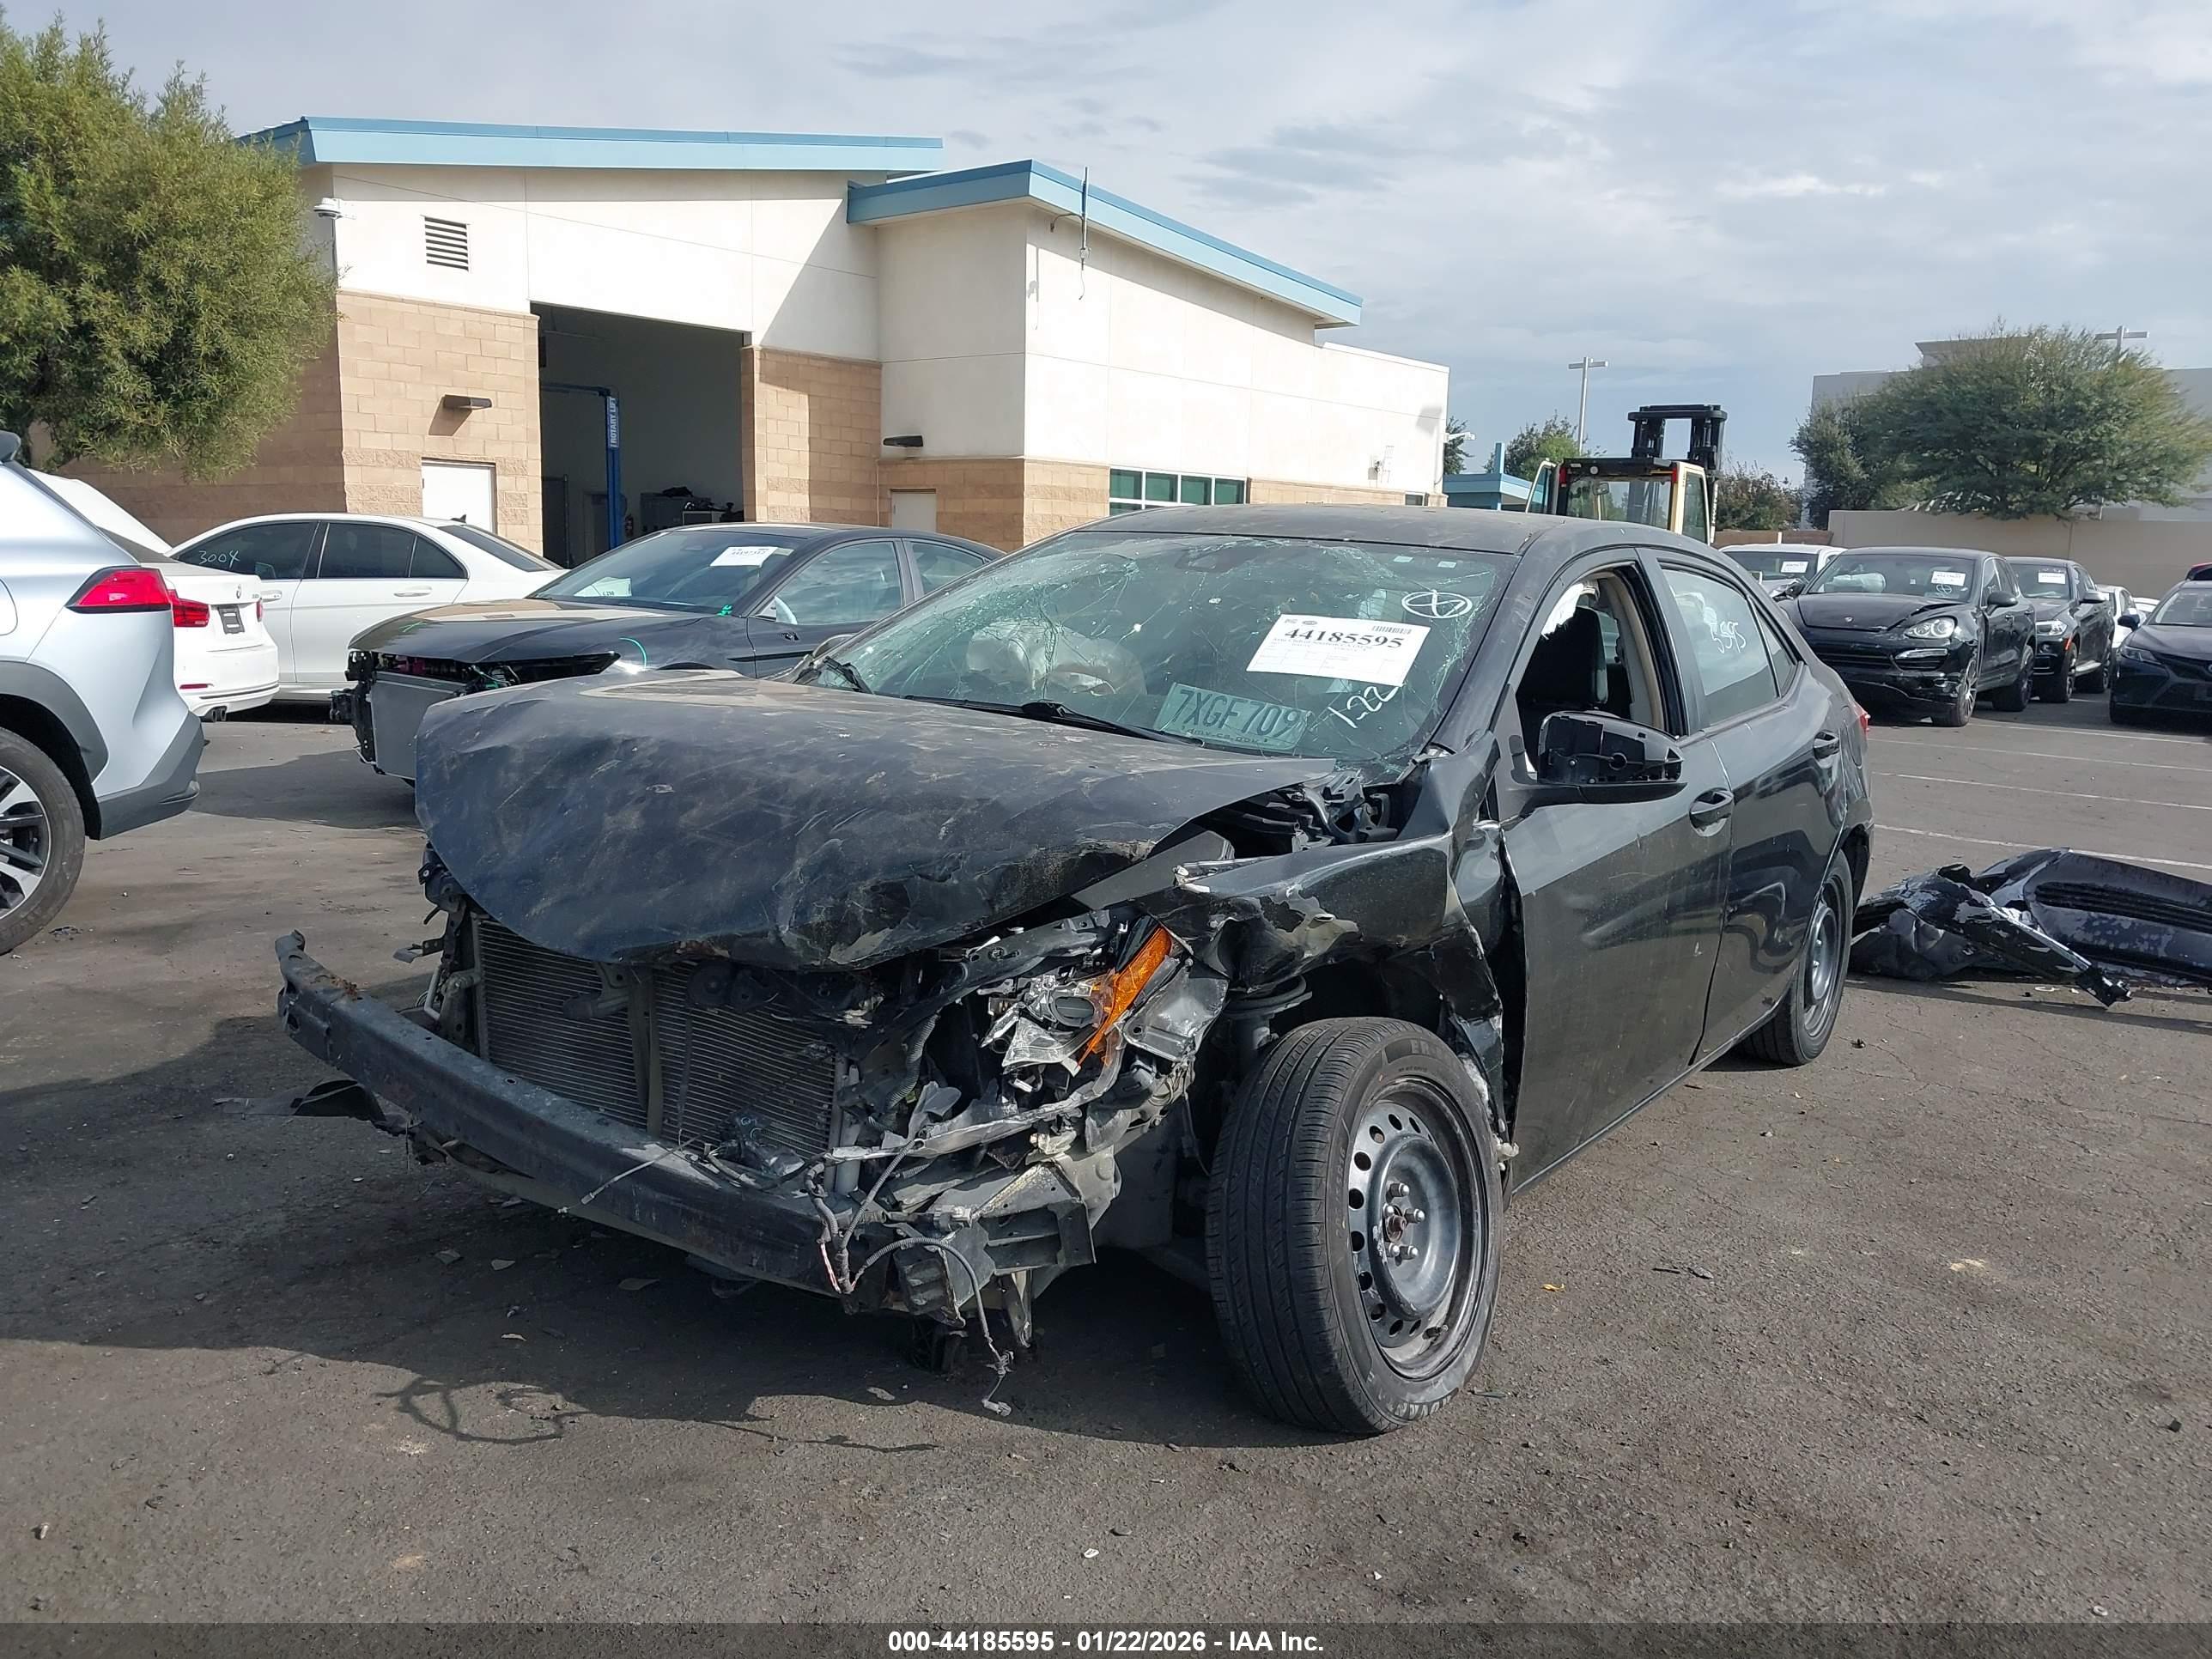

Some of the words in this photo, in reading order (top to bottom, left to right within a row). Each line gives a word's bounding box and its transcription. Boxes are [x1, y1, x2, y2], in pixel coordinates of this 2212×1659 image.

[198, 549, 241, 569] 3004
[1284, 628, 1406, 649] 44185595
[1171, 689, 1302, 738] 7XGF709
